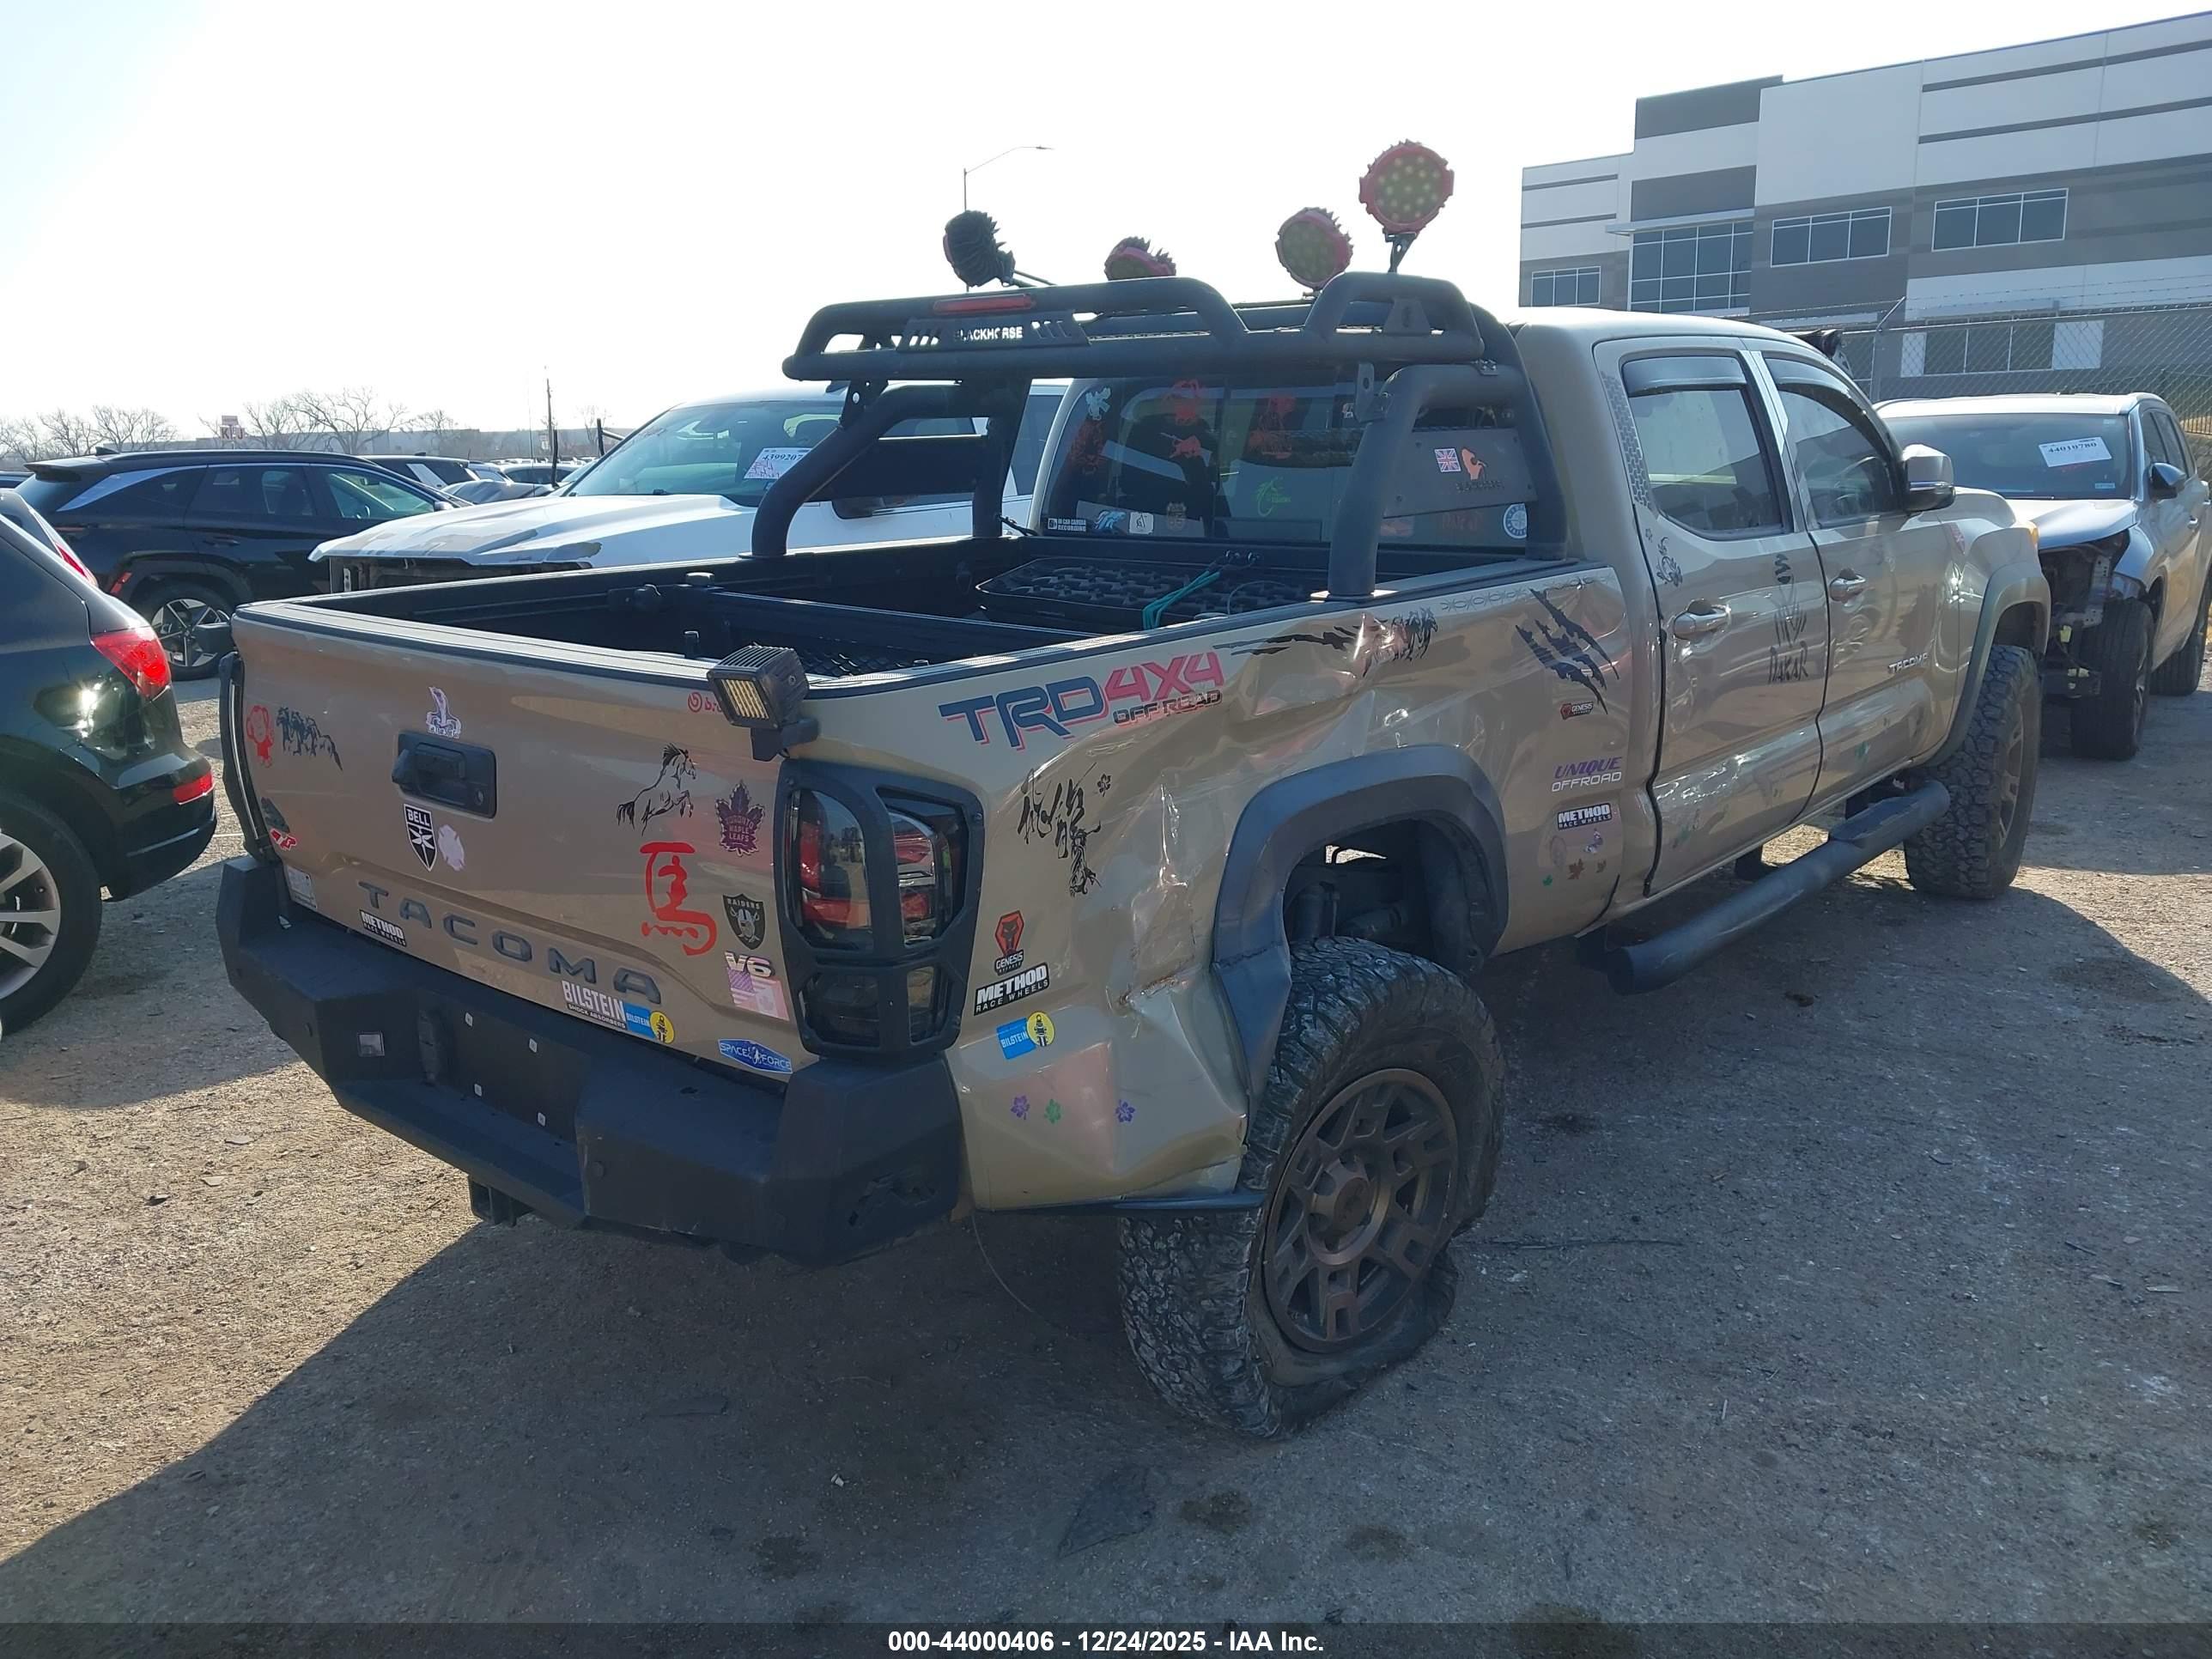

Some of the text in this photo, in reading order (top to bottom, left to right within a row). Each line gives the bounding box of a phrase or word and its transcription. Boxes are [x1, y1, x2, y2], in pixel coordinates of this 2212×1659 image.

[938, 676, 1109, 751] TRD
[1113, 689, 1223, 726] OFF ROAD
[1554, 757, 1622, 779] UNIQUE
[1552, 771, 1622, 792] OFFROAD
[407, 808, 430, 826] BELL
[1559, 805, 1611, 823] METHOD
[1581, 814, 1612, 824] WHEELS
[729, 832, 750, 842] LEAFS
[726, 897, 761, 910] RAIDERS
[361, 910, 404, 939] METHOD
[357, 880, 662, 1006] TACOMA
[724, 951, 772, 978] V6
[995, 951, 1024, 969] GENESIS
[975, 979, 1048, 1012] RACE WHEELS
[976, 965, 1048, 1006] METHOD
[562, 980, 627, 1023] BILSTEIN
[1000, 1030, 1029, 1048] BILSTEIN
[720, 1042, 792, 1069] SPACE FORCE
